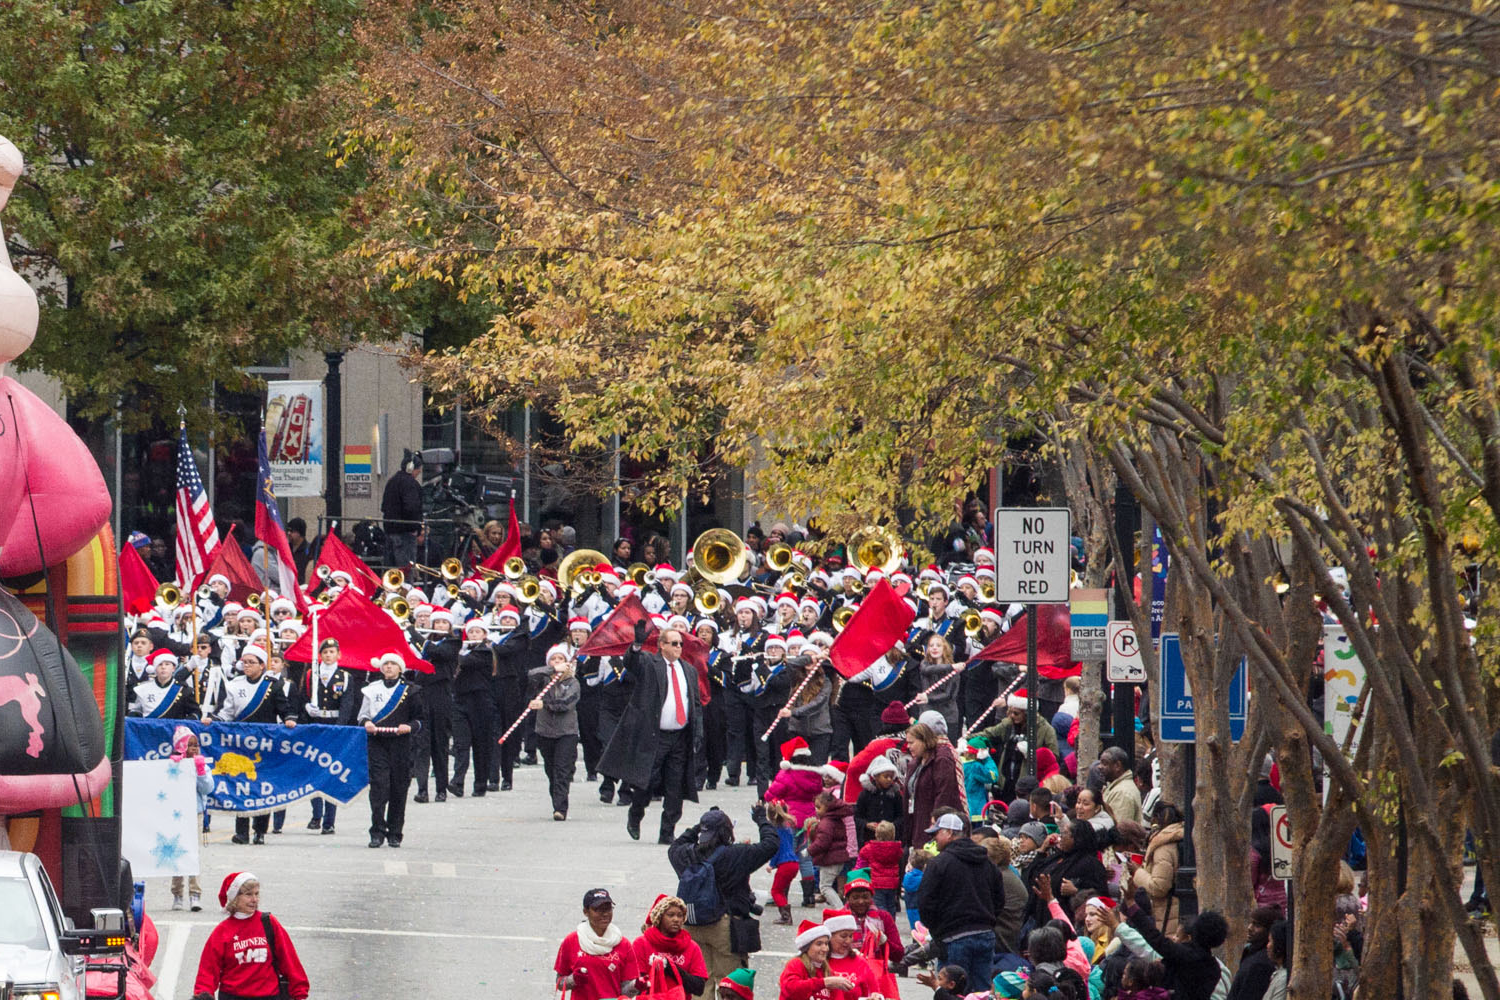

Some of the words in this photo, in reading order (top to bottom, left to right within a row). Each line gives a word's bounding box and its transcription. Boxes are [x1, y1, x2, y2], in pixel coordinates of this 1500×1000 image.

[286, 400, 306, 448] FOX
[1022, 517, 1045, 535] NO
[1012, 540, 1054, 554] TURN
[1023, 560, 1045, 575] ON
[1017, 580, 1049, 594] RED
[1072, 628, 1106, 638] marta
[220, 733, 273, 752] HIGH
[280, 740, 351, 784] SCHOOL
[215, 781, 274, 796] AND
[243, 783, 315, 808] GEORGIA
[233, 936, 268, 951] PARTNERS
